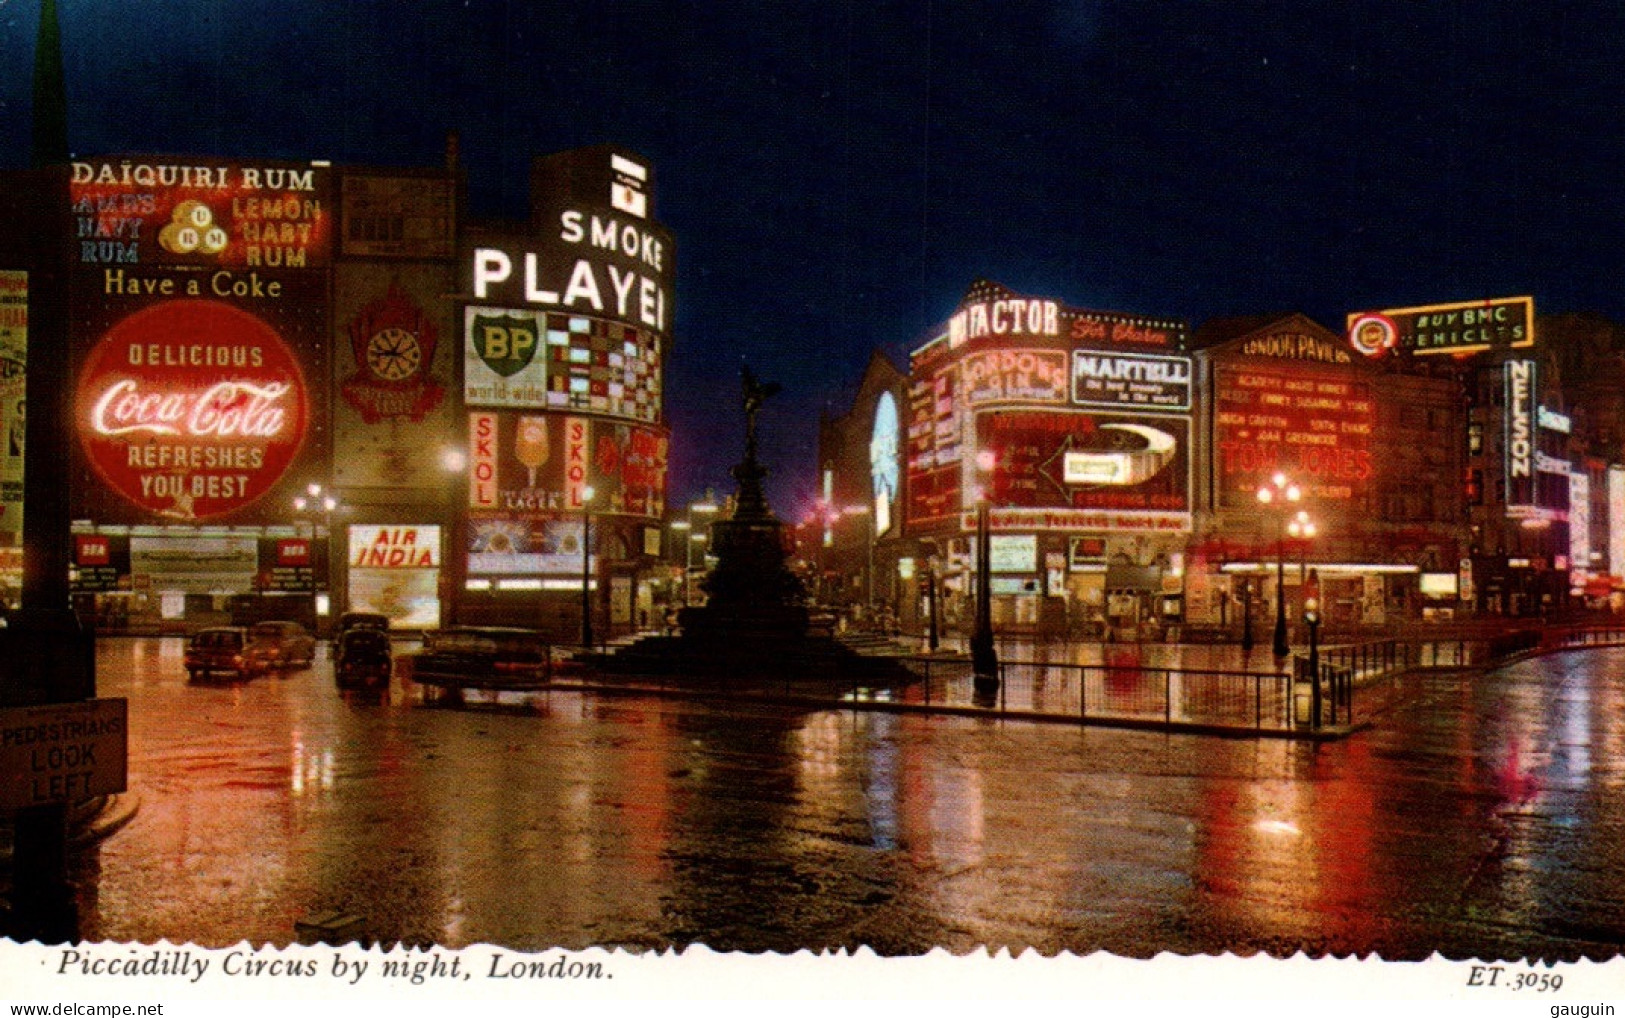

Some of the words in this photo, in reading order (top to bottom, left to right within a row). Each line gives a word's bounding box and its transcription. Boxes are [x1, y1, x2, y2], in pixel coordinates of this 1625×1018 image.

[241, 168, 315, 191] RUM
[232, 198, 321, 222] LEMON
[77, 217, 142, 239] NAVY
[81, 241, 139, 263] RUM
[561, 210, 662, 273] SMOKE
[246, 246, 306, 267] RUM
[105, 269, 174, 295] Have
[187, 279, 200, 295] a
[212, 271, 281, 297] Coke
[1463, 307, 1507, 325] BMC
[129, 344, 263, 367] DELICIOUS
[484, 326, 533, 360] BP
[1077, 355, 1190, 384] MARTELL
[1511, 359, 1530, 478] NELSON
[128, 446, 263, 469] REFRESHES
[477, 417, 492, 505] SKOL
[569, 423, 584, 507] SKOL
[1219, 441, 1278, 473] TOM
[1298, 446, 1372, 480] JONES
[140, 476, 184, 498] YOU
[191, 475, 249, 498] BEST
[376, 528, 417, 545] AIR
[357, 547, 432, 567] INDIA
[2, 717, 120, 745] PEDESTRIANS
[31, 743, 96, 772] LOOK
[32, 771, 93, 801] LEFT
